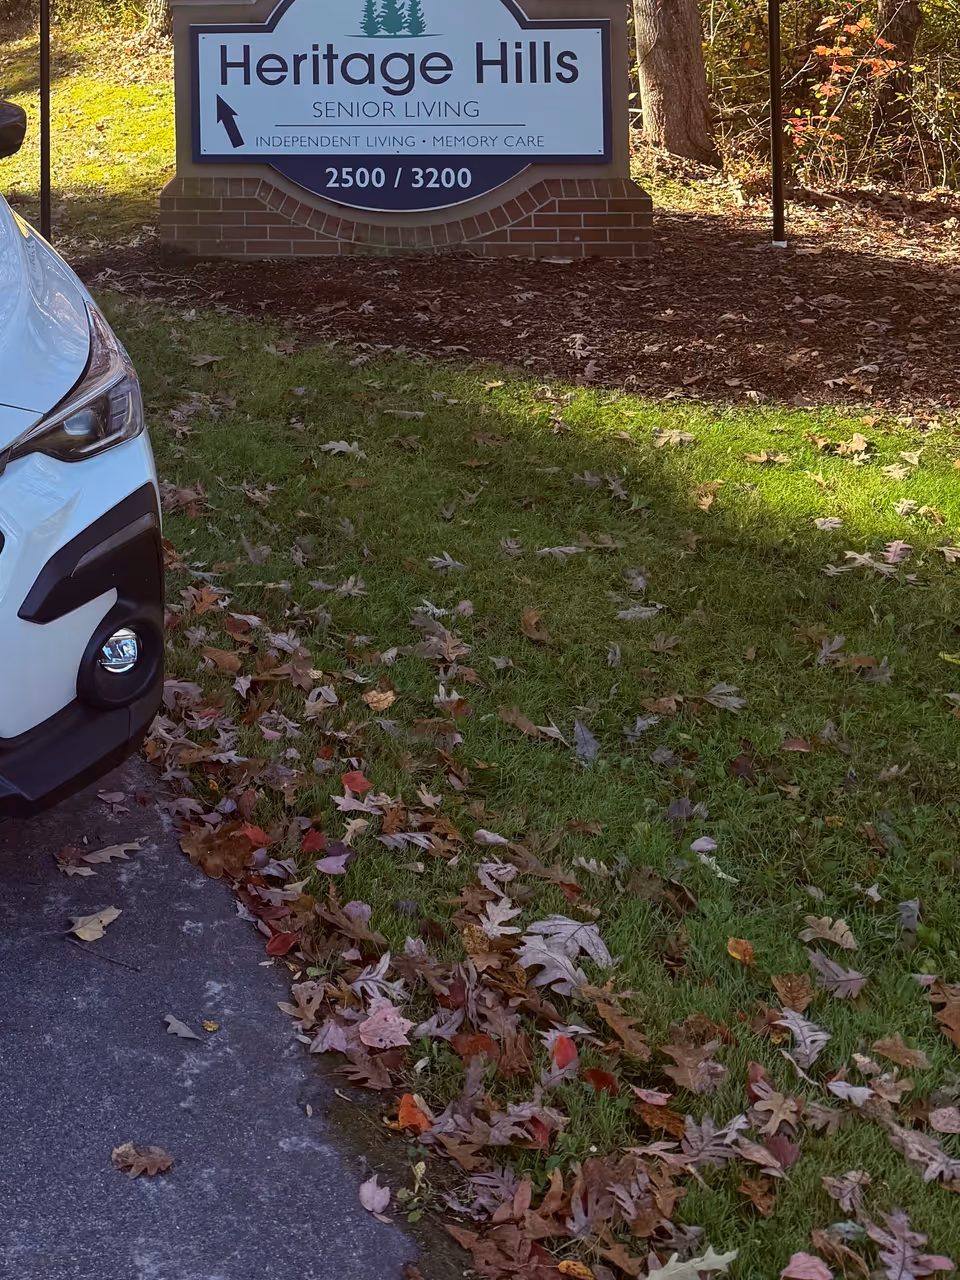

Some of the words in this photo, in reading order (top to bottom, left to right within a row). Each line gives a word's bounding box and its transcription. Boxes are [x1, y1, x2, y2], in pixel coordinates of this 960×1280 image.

[220, 43, 453, 96] Heritage
[475, 41, 579, 85] Hills
[312, 100, 396, 118] SENIOR
[404, 100, 480, 119] LIVING
[254, 135, 361, 148] INDEPENDENT
[366, 135, 416, 148] LIVING
[432, 135, 498, 148] MEMORY
[504, 134, 545, 148] CARE
[325, 167, 386, 189] 2500
[411, 166, 472, 188] 3200
